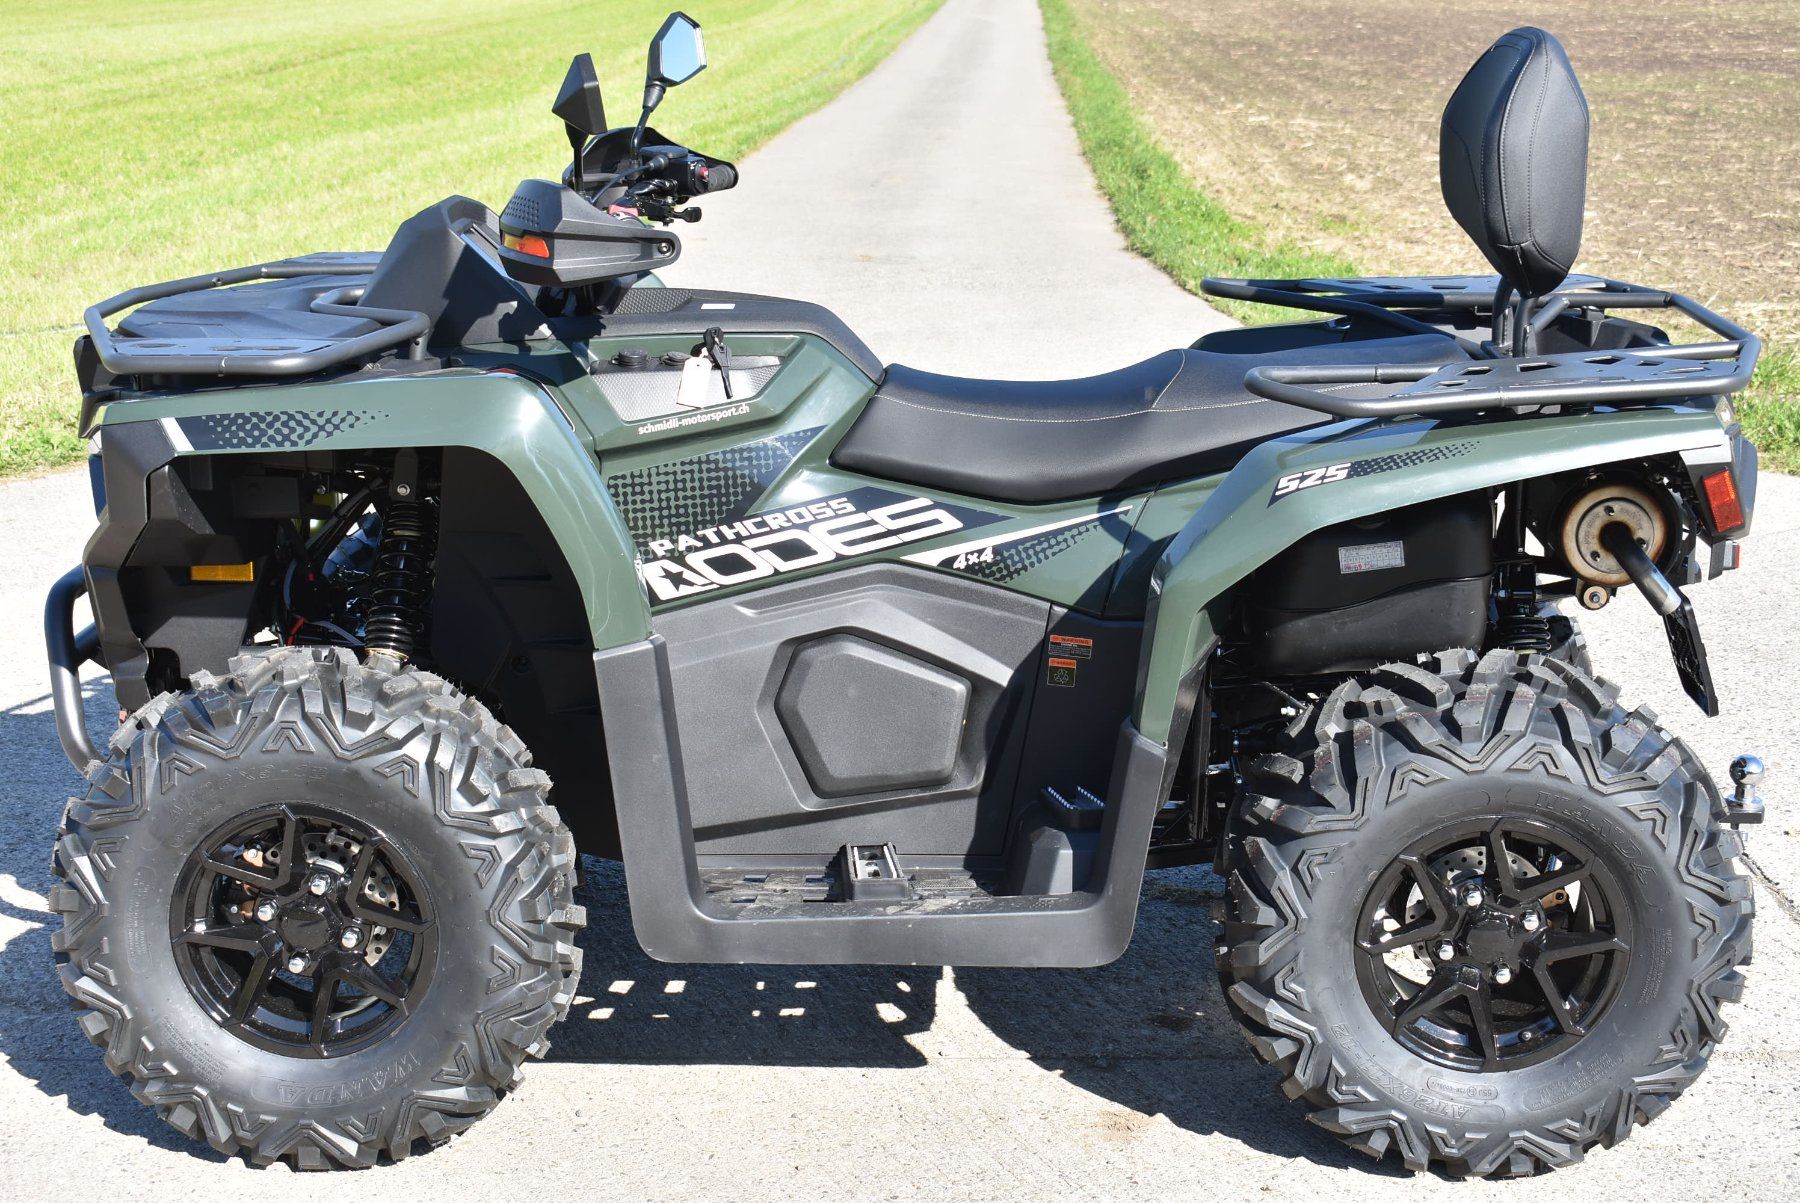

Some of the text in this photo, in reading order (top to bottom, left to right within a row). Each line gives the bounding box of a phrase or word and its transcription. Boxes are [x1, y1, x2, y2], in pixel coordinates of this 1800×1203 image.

[638, 404, 750, 435] schmidli-motorsport.ch
[1275, 462, 1352, 496] 525
[648, 497, 857, 557] PATHCROSS
[953, 546, 993, 570] 4x4
[278, 1048, 421, 1106] WANDA
